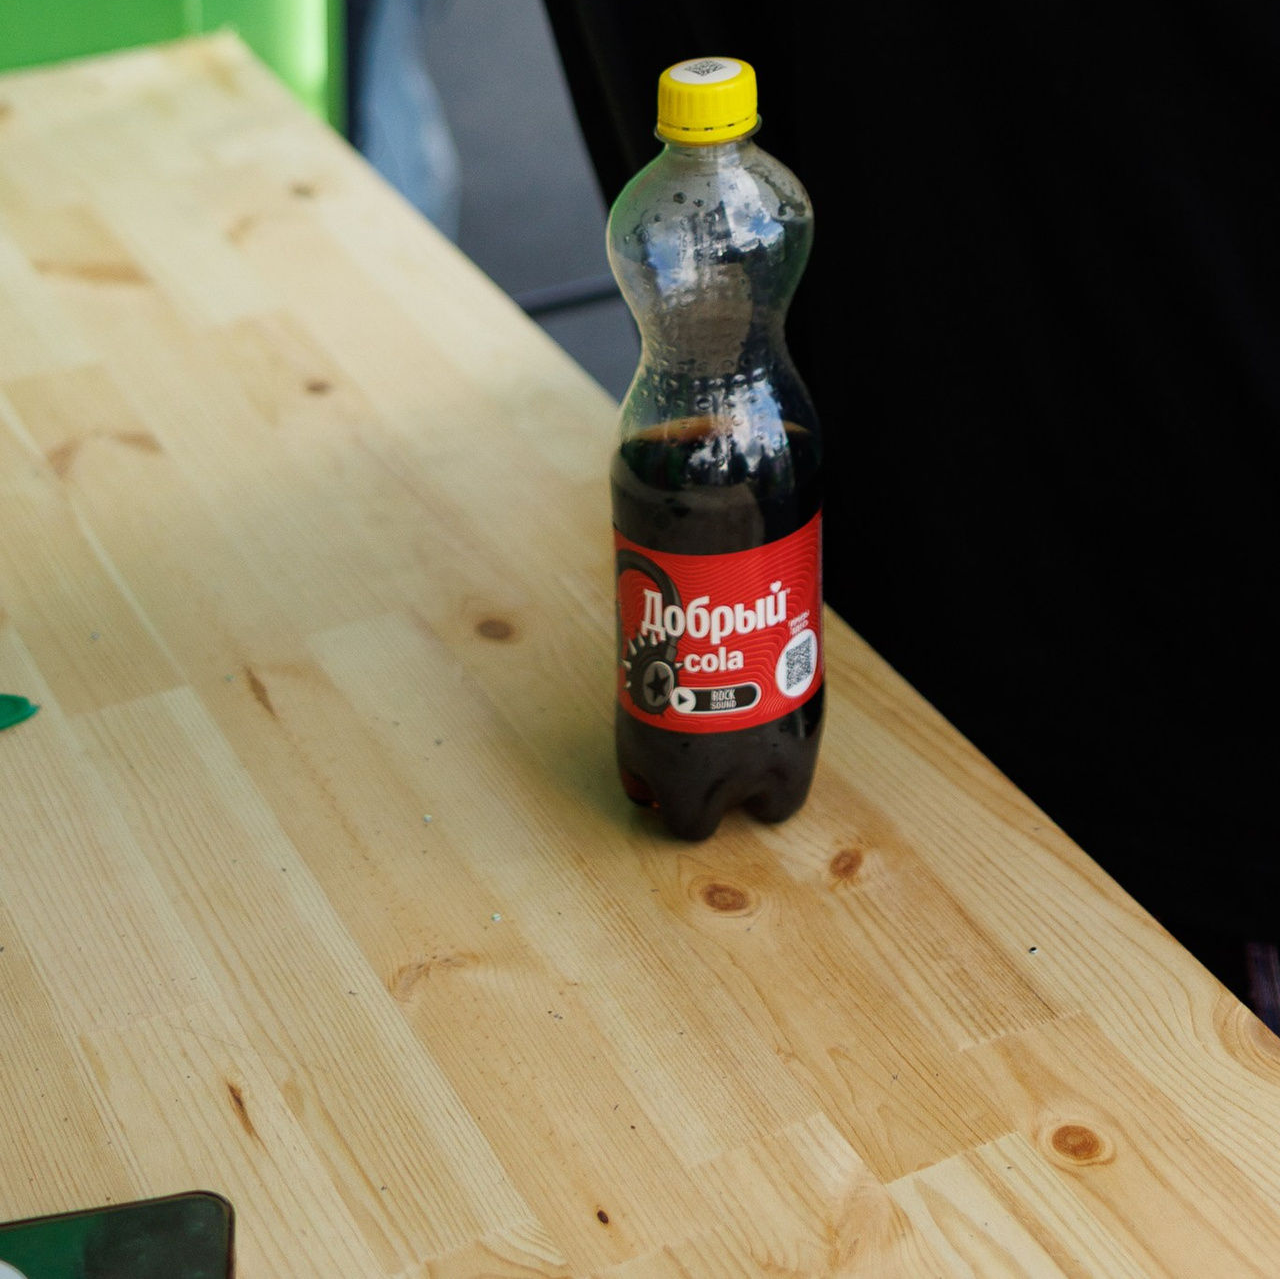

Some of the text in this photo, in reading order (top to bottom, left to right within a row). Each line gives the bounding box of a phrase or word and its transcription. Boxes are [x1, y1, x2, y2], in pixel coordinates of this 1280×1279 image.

[641, 580, 788, 645] Добрый
[683, 646, 744, 673] cola
[711, 688, 736, 701] ROCK
[710, 700, 737, 710] SOUND
